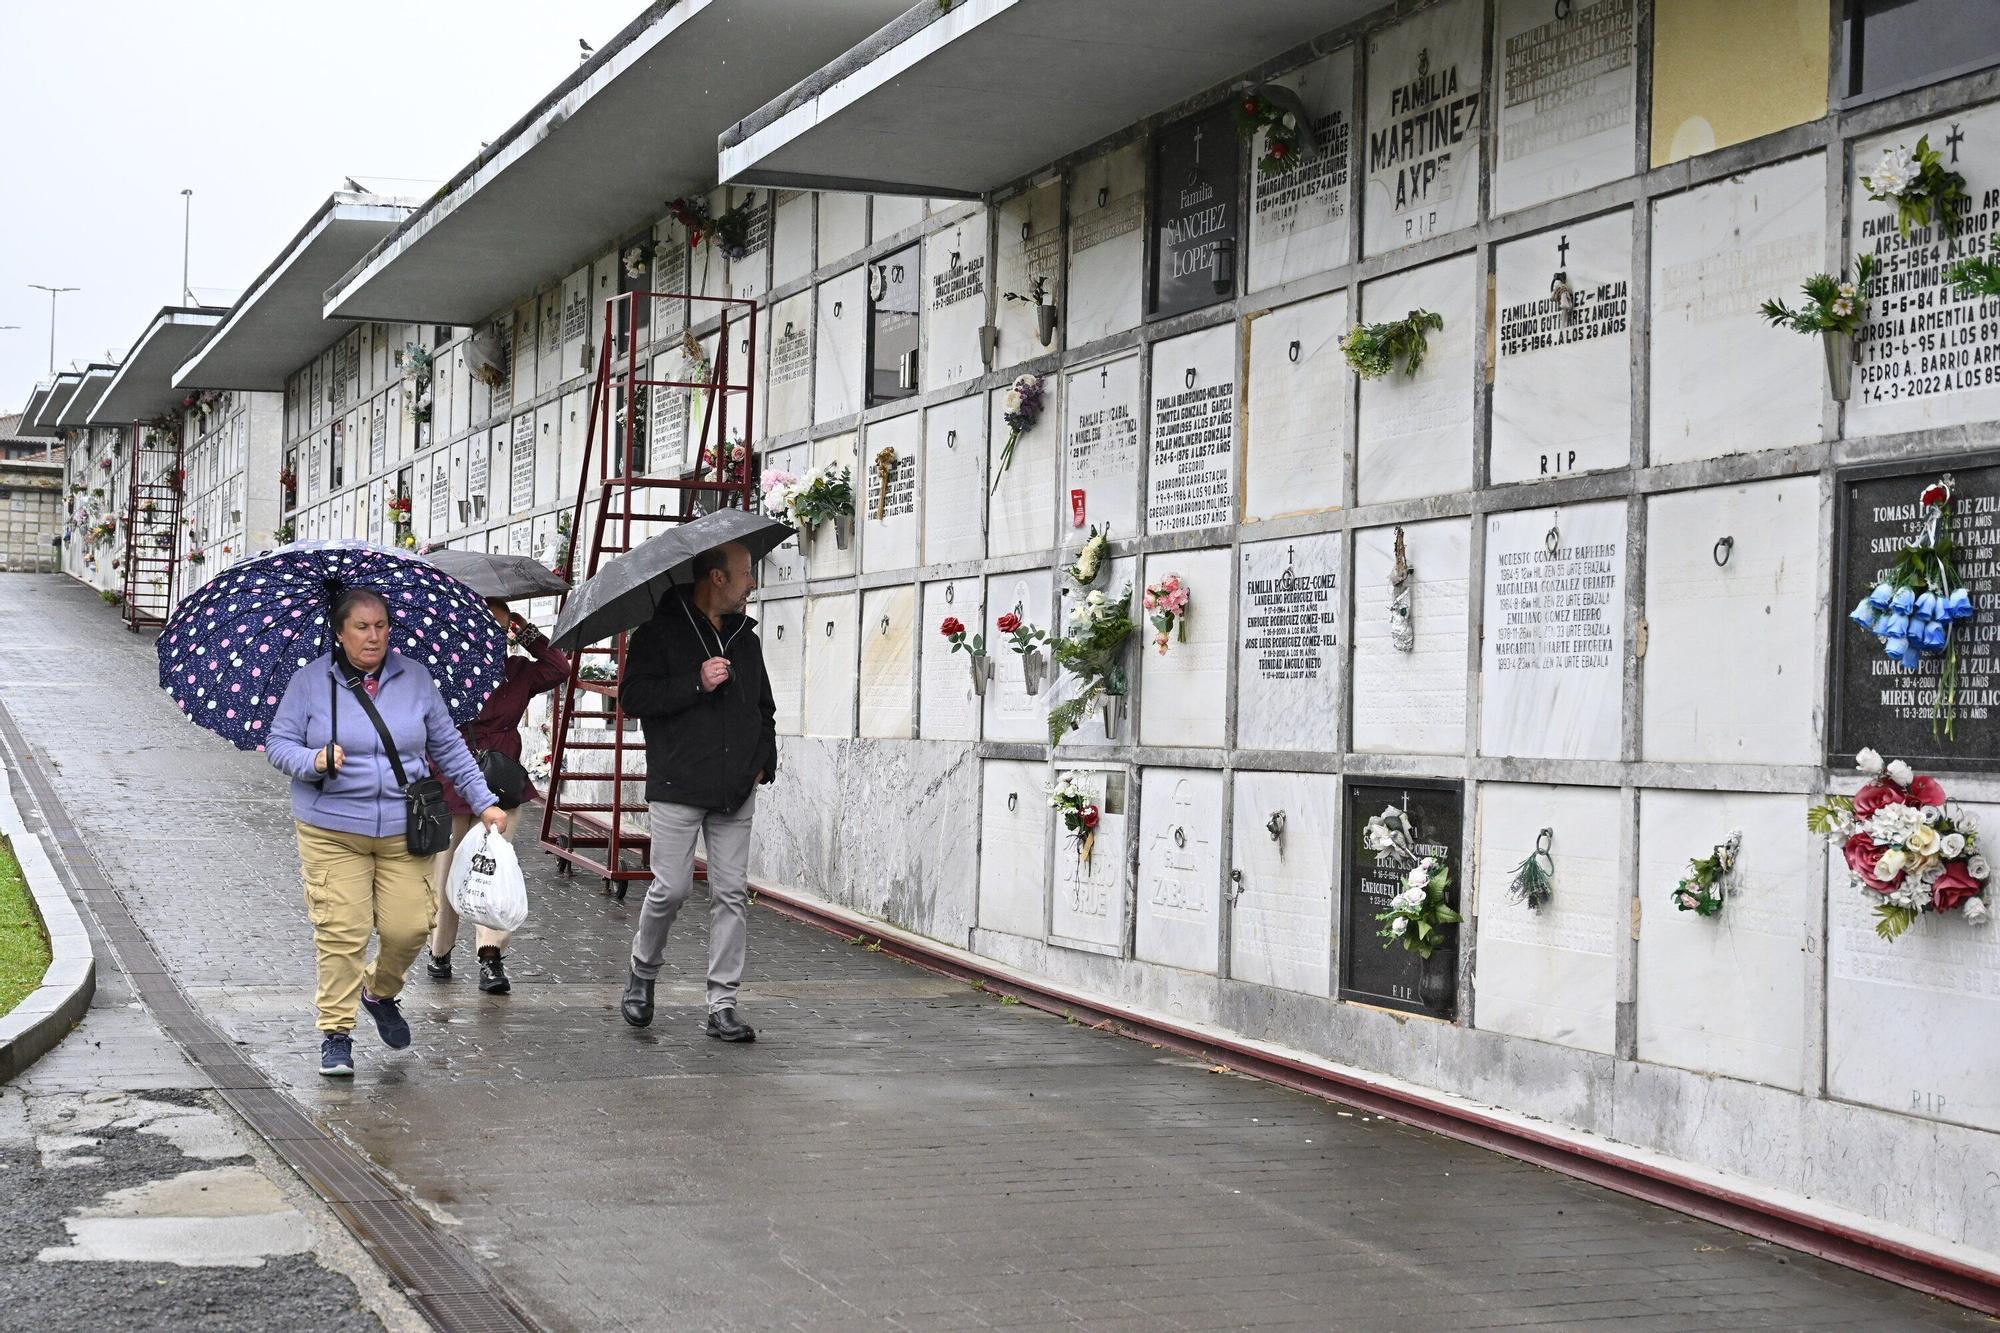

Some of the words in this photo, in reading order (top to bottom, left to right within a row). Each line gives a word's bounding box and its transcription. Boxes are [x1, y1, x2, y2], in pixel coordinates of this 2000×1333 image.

[1392, 66, 1458, 117] FAMILIA
[1371, 93, 1480, 173] MARTINEZ
[1330, 138, 1348, 157] AÑOS
[1180, 181, 1213, 209] Familia
[1166, 204, 1226, 247] SANCHEZ
[1958, 235, 1986, 257] LOS
[1891, 266, 1939, 293] ANTONIO
[1882, 291, 1933, 316] 9-6-84
[1940, 288, 1947, 305] A
[1502, 299, 1536, 324] FAMILIA
[1910, 305, 1974, 334] ARMENTIA
[1501, 318, 1537, 341] SEGUNDO
[1592, 300, 1627, 323] ANGULO
[1558, 329, 1564, 345] A
[1566, 327, 1583, 344] LOS
[1586, 325, 1598, 339] 28
[1601, 318, 1626, 337] AÑOS
[1880, 333, 1935, 360] 13-6-95
[1940, 333, 1946, 350] A
[1952, 326, 1976, 347] LOS
[1980, 322, 1998, 341] 89
[1861, 362, 1899, 384] PEDRO
[1903, 360, 1917, 377] A.
[1921, 350, 1969, 373] BARRIO
[1873, 376, 1940, 402] 4-3-2022
[1944, 374, 1952, 391] A
[1957, 369, 1981, 389] LOS
[1985, 367, 2000, 384] 85
[1157, 396, 1176, 411] FAMILIA
[1157, 409, 1180, 425] TIMOTEA
[1181, 403, 1207, 419] GONZALO
[1212, 397, 1232, 413] GARCIA
[1218, 412, 1232, 425] AÑOS
[1156, 438, 1172, 452] PILAR
[1173, 432, 1202, 449] MOLINERO
[1204, 426, 1231, 443] GONZALO
[1208, 444, 1215, 455] 72
[1216, 440, 1230, 454] AÑOS
[1178, 460, 1204, 474] GREGORIO
[1156, 477, 1185, 491] IBARRONDO
[1188, 489, 1191, 499] A
[1193, 487, 1202, 499] LOS
[1204, 485, 1211, 496] 90
[1213, 482, 1227, 495] AÑOS
[1149, 505, 1174, 518] GREGORIO
[1175, 500, 1205, 515] IBARRONDO
[1873, 504, 1916, 522] TOMASA
[1958, 499, 1972, 514] DE
[1186, 516, 1190, 526] A
[1191, 514, 1201, 526] LOS
[1203, 513, 1210, 524] 87
[1211, 509, 1226, 523] AÑOS
[1975, 514, 1992, 527] AÑOS
[1499, 552, 1530, 566] MODESTO
[1976, 546, 1992, 559] AÑOS
[1567, 563, 1581, 576] URTE
[1584, 561, 1611, 574] EBAZALA
[1248, 580, 1272, 594] FAMILIA
[1496, 581, 1538, 596] MAGDALENA
[1974, 579, 1992, 591] AÑOS
[1314, 590, 1327, 601] VELA
[1566, 594, 1580, 606] URTE
[1248, 617, 1269, 627] ENRIQUE
[1507, 611, 1541, 625] EMILIANO
[1573, 608, 1601, 621] HIERRO
[1566, 625, 1581, 637] URTE
[1583, 624, 1610, 636] EBAZALA
[1245, 638, 1258, 648] JOSE
[1259, 638, 1271, 648] LUIS
[1973, 642, 1990, 655] AÑOS
[1284, 658, 1304, 669] ANGULO
[1305, 658, 1321, 668] NIETO
[1565, 656, 1579, 668] URTE
[1581, 655, 1608, 668] EBAZALA
[1961, 677, 1969, 688] 70
[1972, 674, 1989, 687] AÑOS
[1881, 690, 1915, 706] MIREN
[1970, 706, 1987, 719] AÑOS
